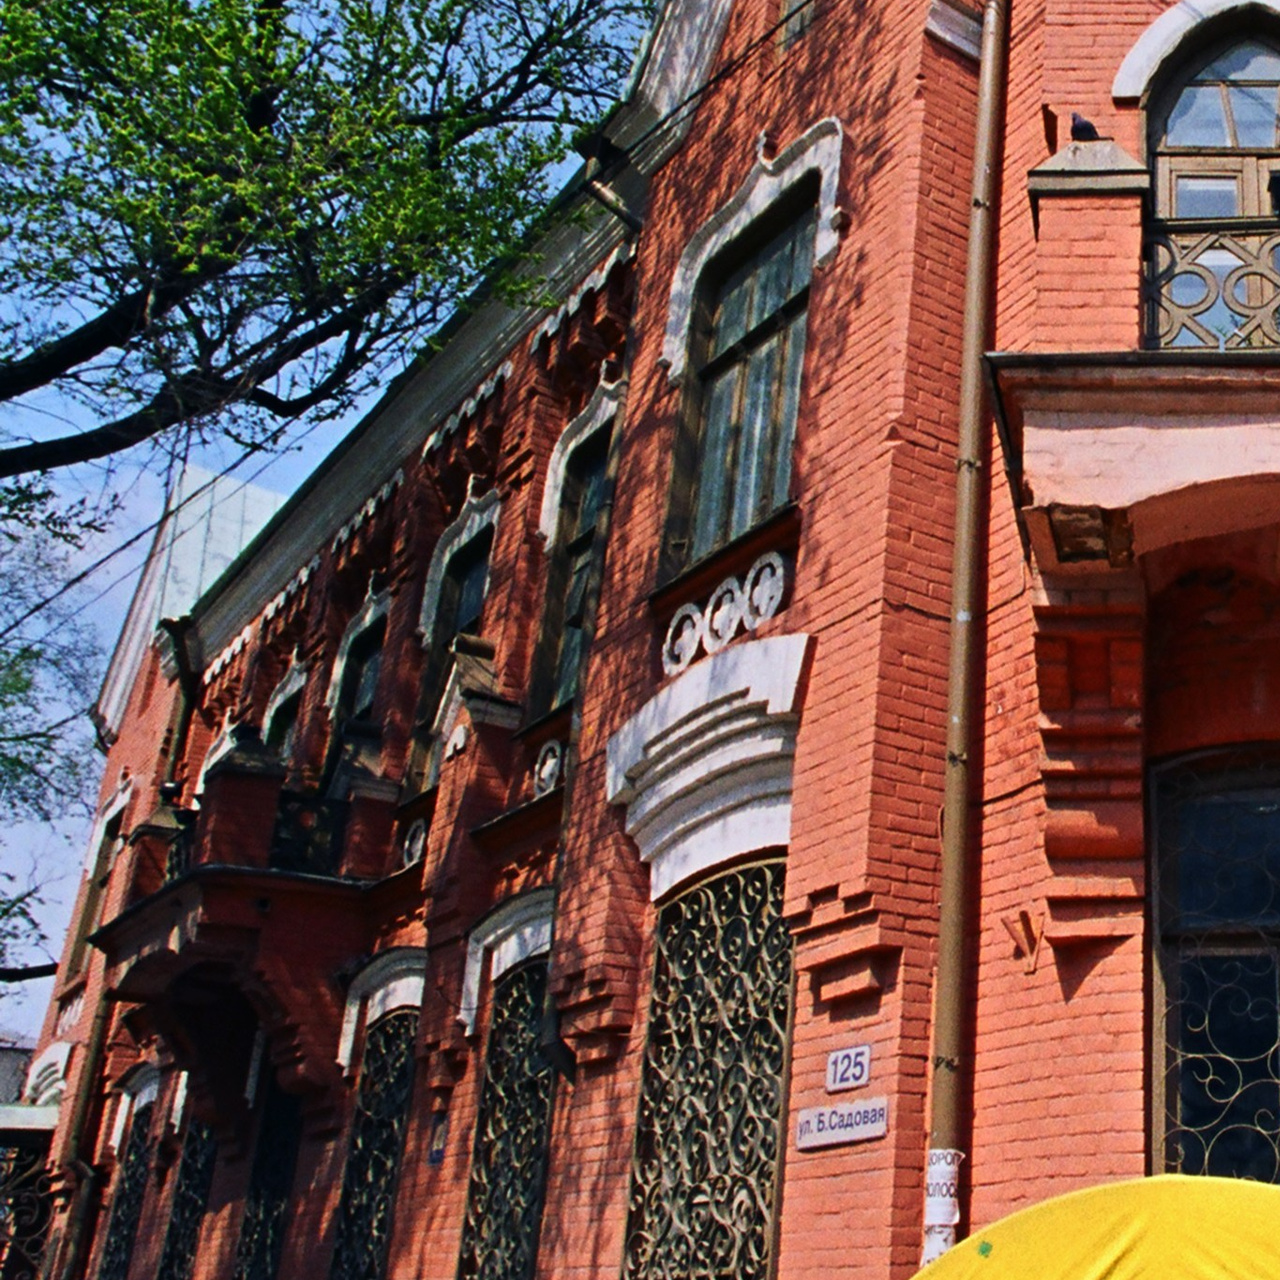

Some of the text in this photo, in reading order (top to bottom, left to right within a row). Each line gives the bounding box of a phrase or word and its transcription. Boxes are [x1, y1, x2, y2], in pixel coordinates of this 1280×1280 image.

[830, 1051, 865, 1085] 125
[799, 1107, 885, 1140] ул. Б.Садовая
